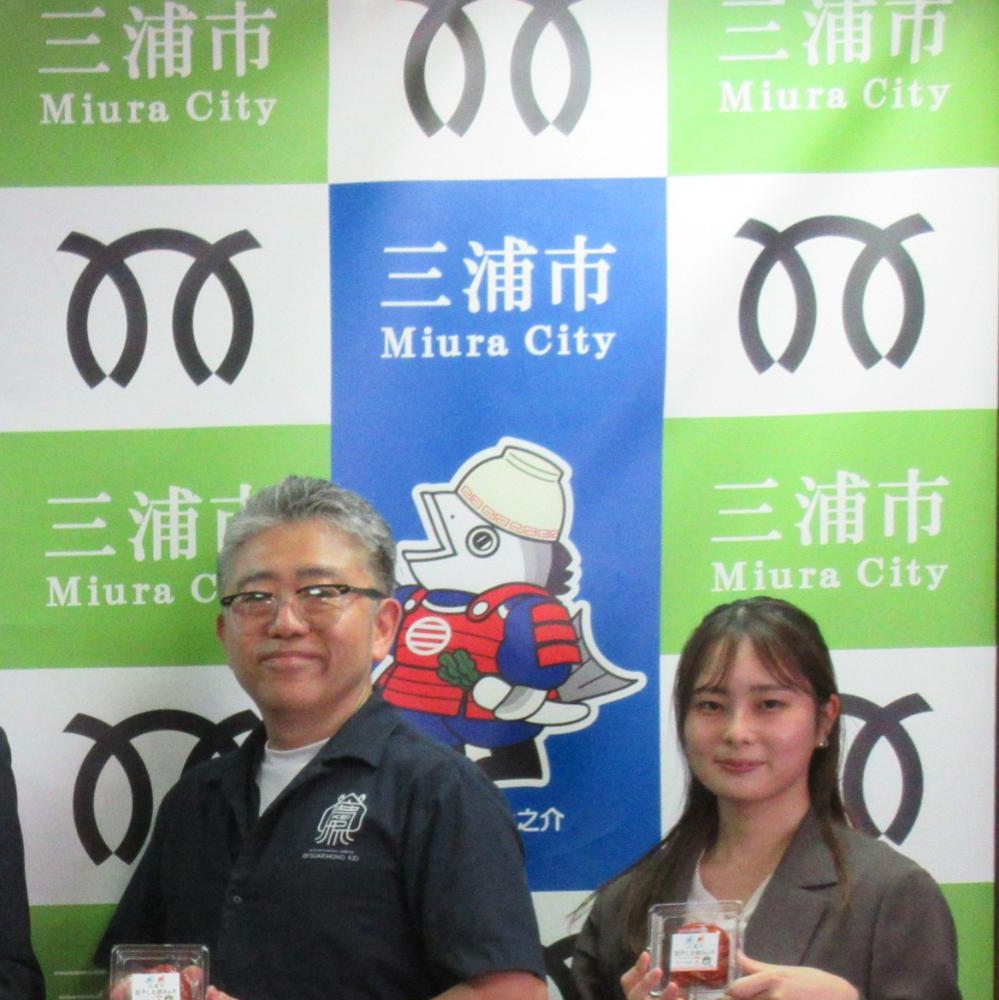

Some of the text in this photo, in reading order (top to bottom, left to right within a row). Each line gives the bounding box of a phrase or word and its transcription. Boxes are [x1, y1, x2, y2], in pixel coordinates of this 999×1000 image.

[38, 1, 278, 79] 三浦市
[717, 0, 952, 66] 三浦市
[40, 90, 277, 126] Miura City
[719, 77, 951, 112] Miura City
[381, 234, 617, 313] 三浦市
[380, 324, 617, 360] Miura City
[711, 468, 950, 546] 三浦市
[46, 575, 175, 607] Miura
[711, 556, 949, 592] Miura City
[513, 806, 565, 832] 之介
